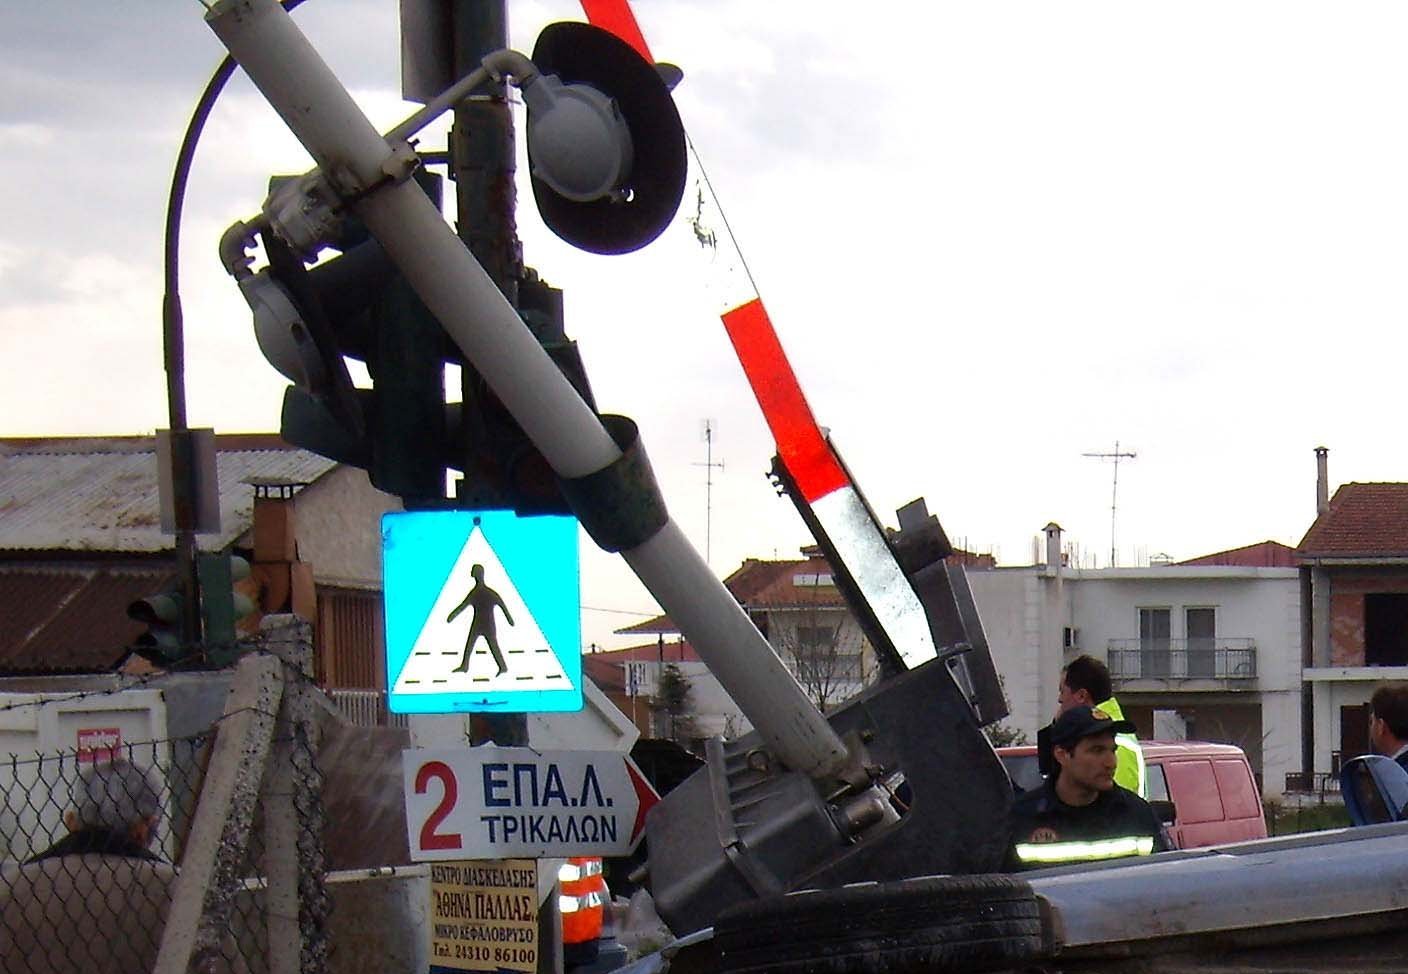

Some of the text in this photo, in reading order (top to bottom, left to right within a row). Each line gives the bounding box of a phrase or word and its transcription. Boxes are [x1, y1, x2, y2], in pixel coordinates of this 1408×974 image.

[414, 760, 614, 851] 2 ΕΠΑ.Λ.
[480, 814, 617, 844] ΤΡΙΚΑΛΩΝ
[432, 865, 535, 888] ΚΕΝΤΡΟ ΔΙΑΣΚΕΔΑΣΗΣ
[460, 925, 534, 943] ΚΕΦΑΛΟΒΡΥΣΟ
[455, 944, 490, 961] 24310
[495, 947, 535, 963] 86100
